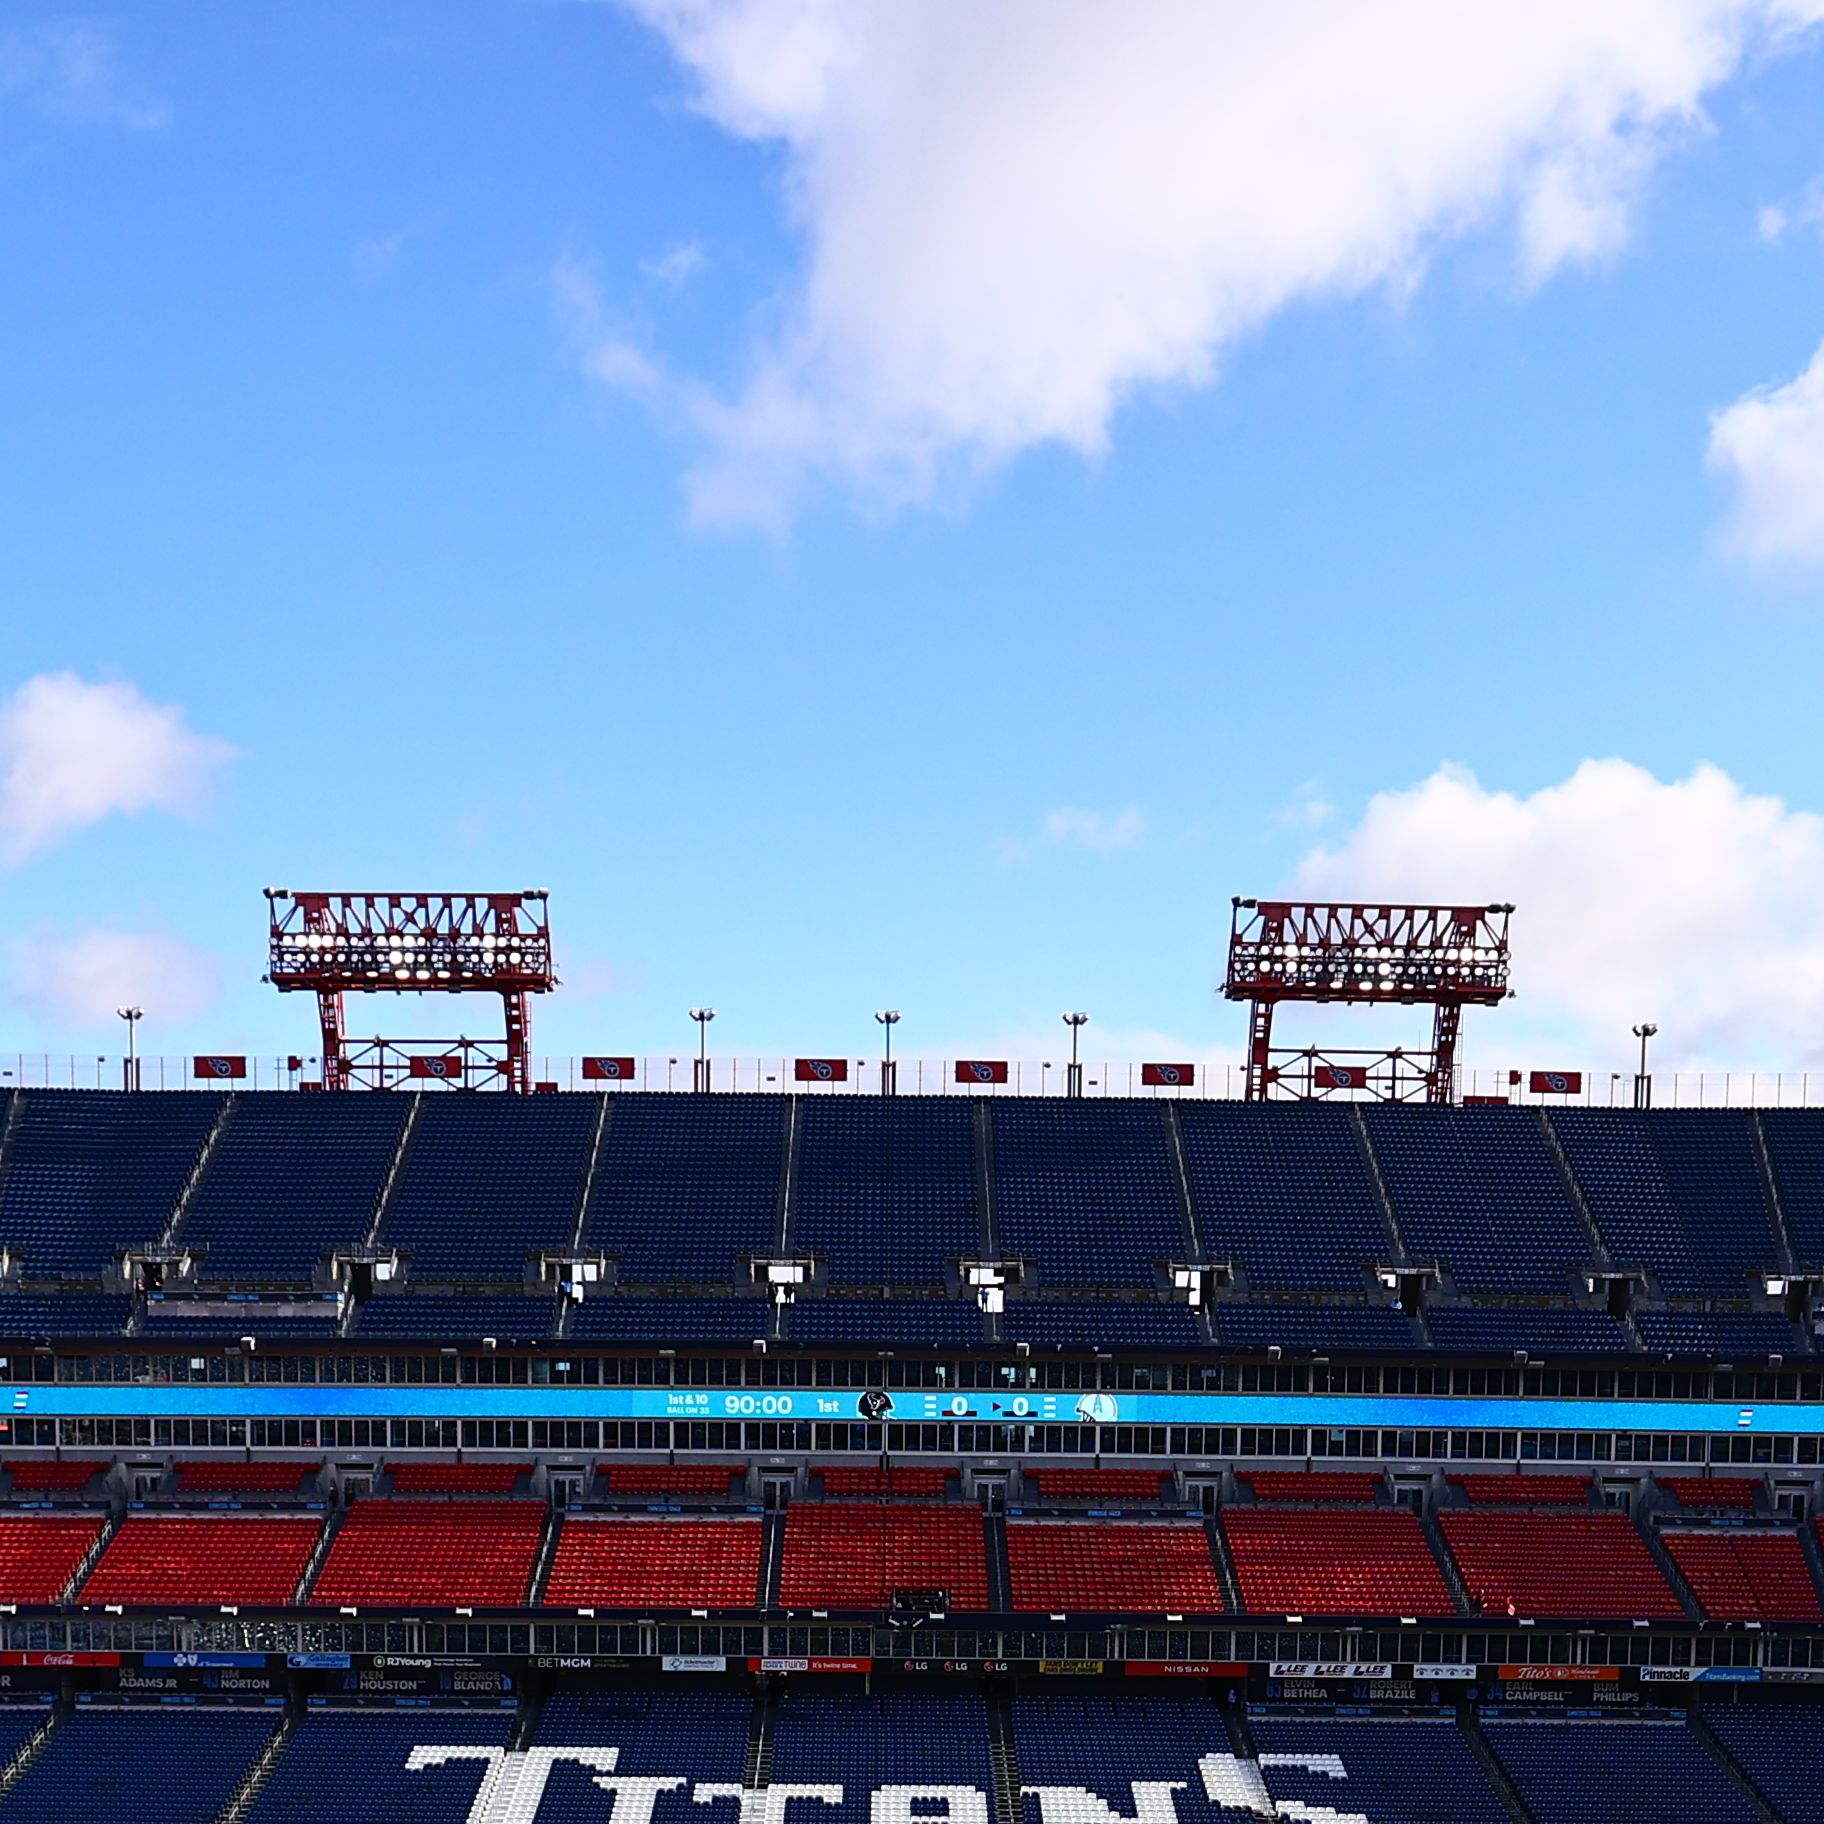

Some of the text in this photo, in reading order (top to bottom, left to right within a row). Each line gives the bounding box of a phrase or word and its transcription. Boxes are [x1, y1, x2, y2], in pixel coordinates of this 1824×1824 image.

[668, 1393, 683, 1405] 1st
[694, 1393, 709, 1404] 10
[724, 1395, 793, 1415] 90:00
[817, 1398, 840, 1413] 1st
[951, 1396, 968, 1416] 0
[1012, 1396, 1029, 1416] 0
[386, 1656, 432, 1669] RJYoung
[537, 1657, 592, 1668] BETMGM
[916, 1662, 928, 1671] LG
[956, 1662, 968, 1671] LG
[996, 1663, 1008, 1671] LG
[1164, 1665, 1209, 1674] NISSAN
[1287, 1664, 1308, 1673] LEE
[1327, 1664, 1348, 1673] LEE
[1366, 1664, 1388, 1673] LEE
[1518, 1666, 1552, 1679] Tito's
[1642, 1668, 1690, 1680] Pinnacle
[119, 1678, 164, 1688] ADAMS
[221, 1679, 270, 1690] NORTON
[359, 1680, 416, 1690] HOUSTON
[1283, 1680, 1316, 1689] ELVIN
[1369, 1680, 1413, 1690] ROBERT
[1505, 1681, 1534, 1691] EARL
[1283, 1688, 1328, 1698] BETHEA
[1369, 1689, 1416, 1699] BRAZILE
[1505, 1690, 1565, 1701] CAMPBELL
[1592, 1691, 1640, 1702] PHILLIPS
